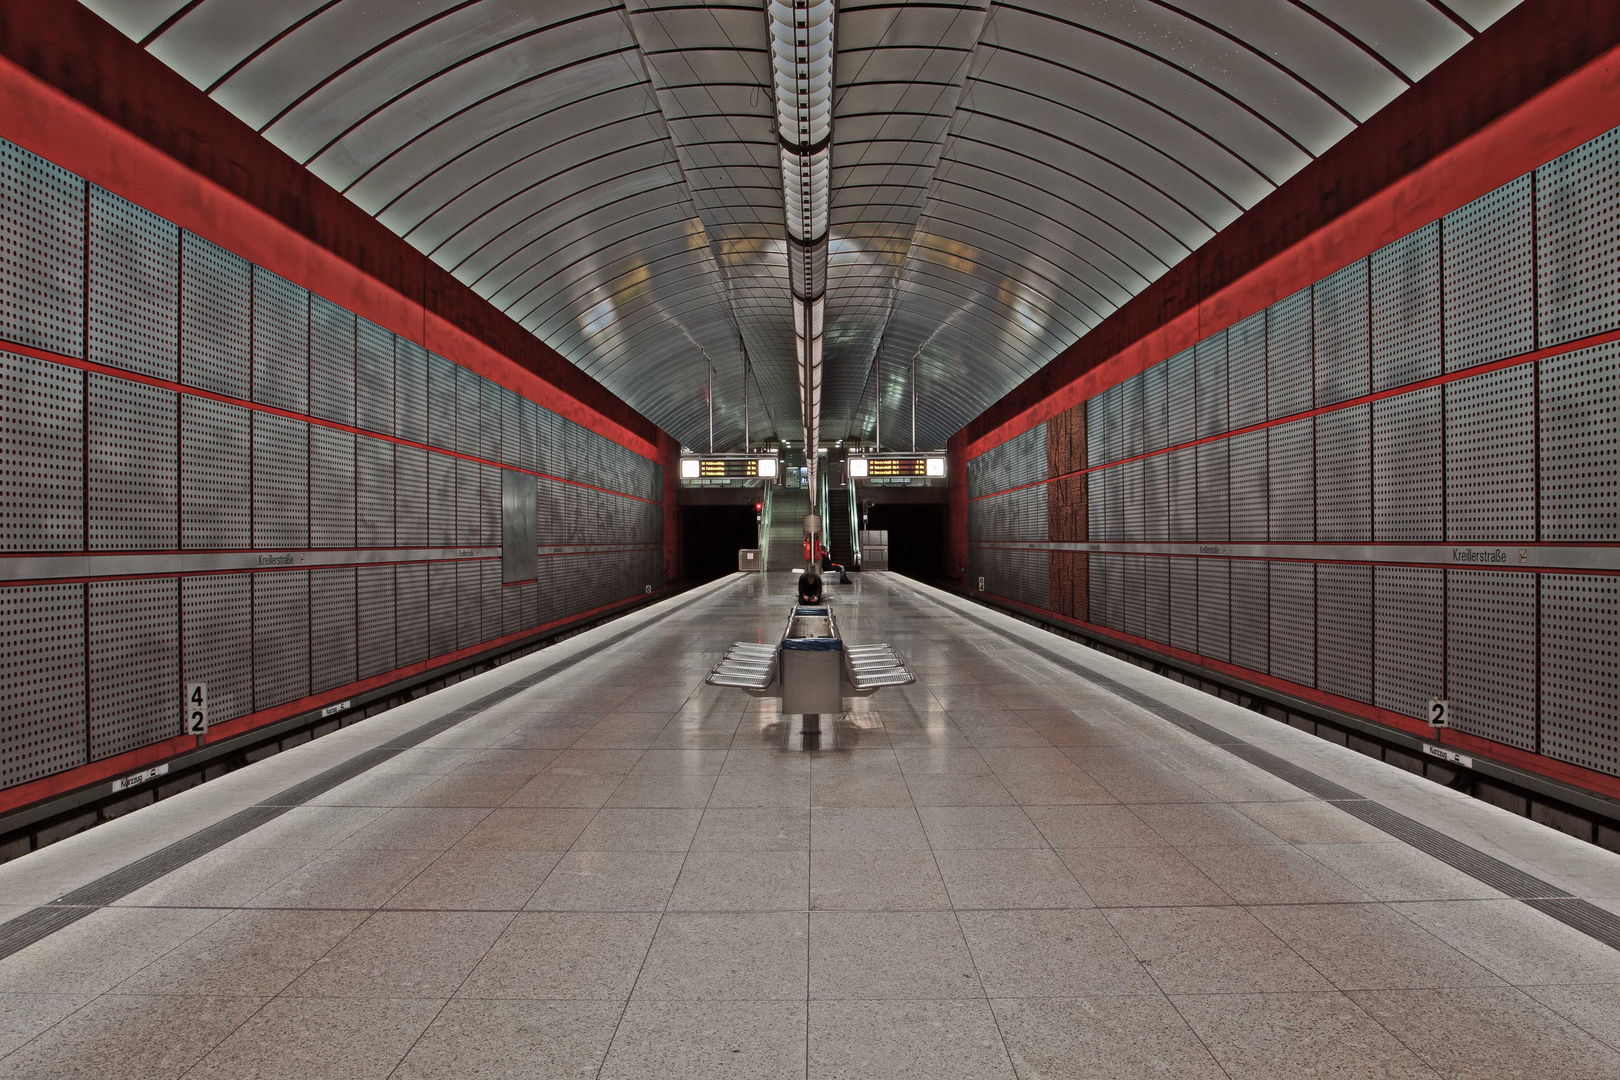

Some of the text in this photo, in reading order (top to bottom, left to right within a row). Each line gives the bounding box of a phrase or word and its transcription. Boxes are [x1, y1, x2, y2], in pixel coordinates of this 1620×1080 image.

[1452, 548, 1506, 562] Kreillerstraße
[191, 686, 204, 706] 4
[192, 711, 204, 731] 2
[1432, 704, 1444, 724] 2
